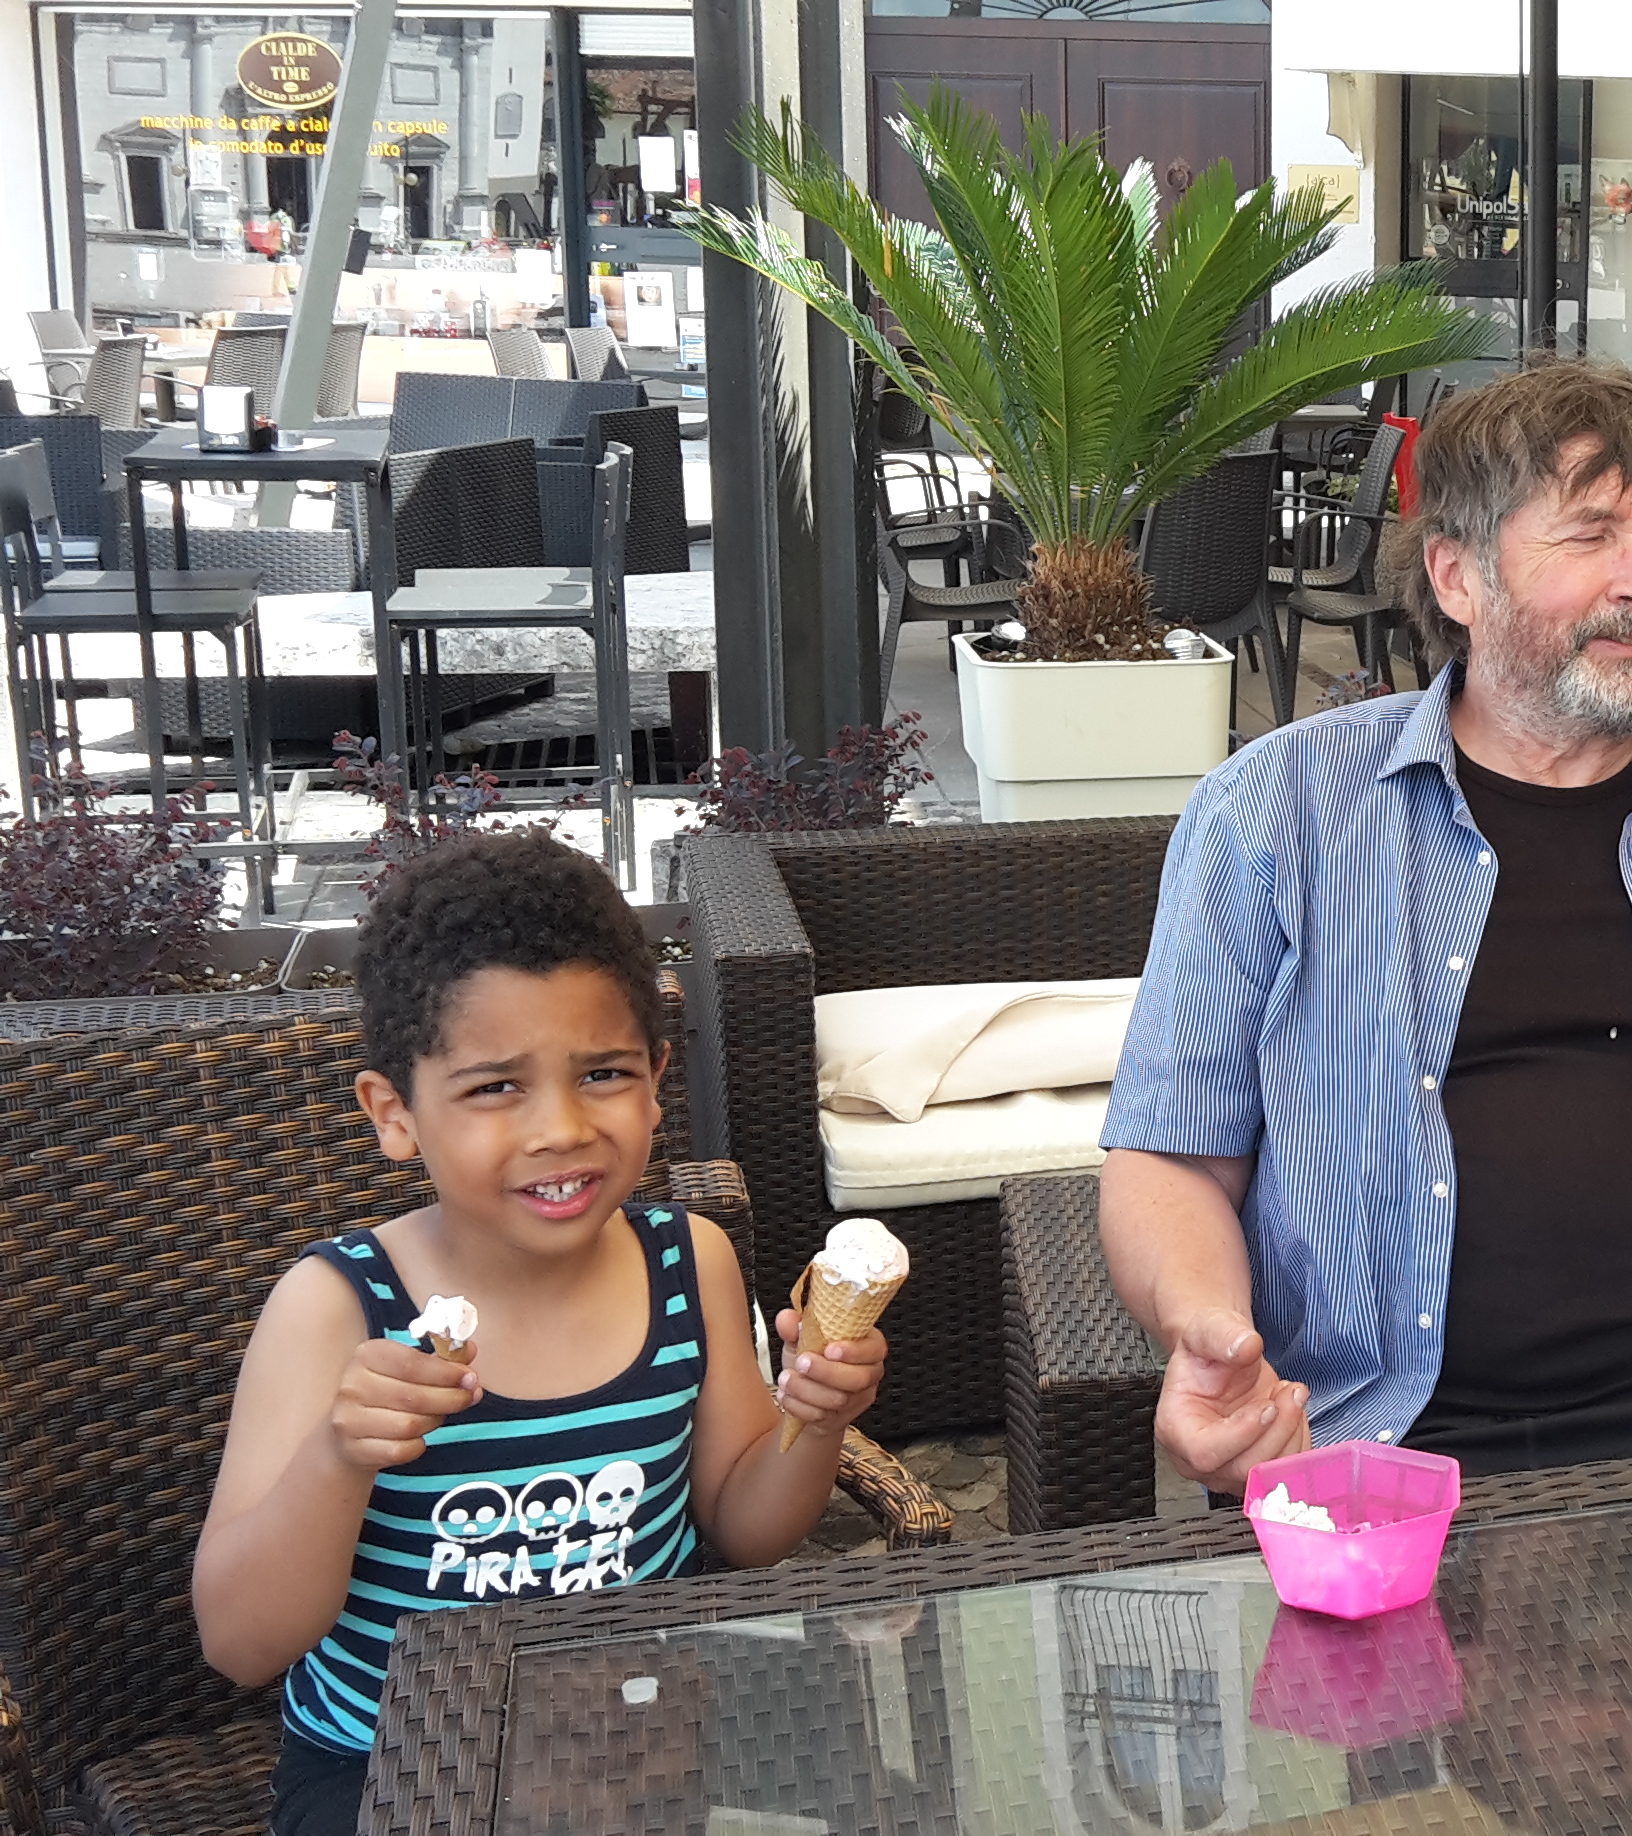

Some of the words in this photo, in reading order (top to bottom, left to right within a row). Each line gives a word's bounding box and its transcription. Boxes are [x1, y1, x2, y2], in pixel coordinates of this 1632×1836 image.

[261, 41, 318, 56] CIALDE
[283, 56, 296, 66] IN
[270, 66, 310, 81] TIME
[139, 114, 213, 129] macchine
[218, 115, 237, 131] da
[240, 115, 280, 131] caffè
[286, 119, 296, 132] a
[300, 117, 330, 132] cial
[372, 119, 384, 133] n
[388, 118, 448, 136] capsule
[204, 139, 284, 155] comodato
[369, 142, 401, 157] uito
[1457, 194, 1528, 219] UnipolS
